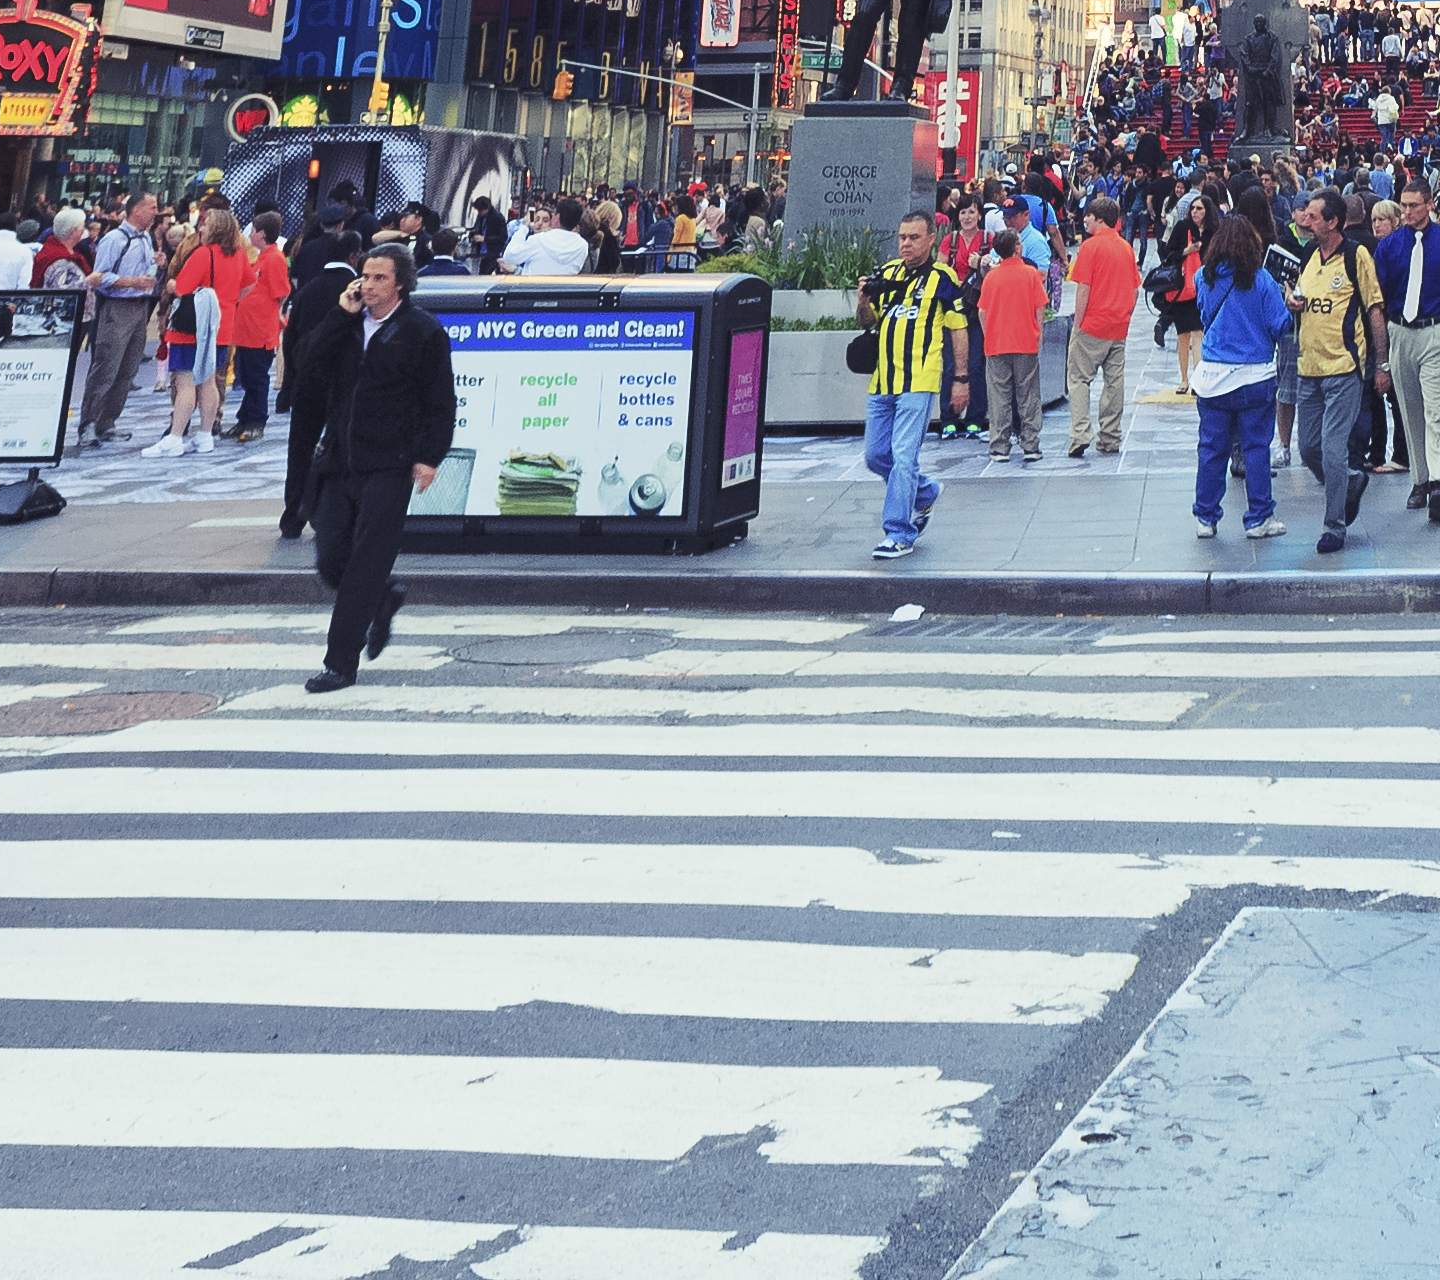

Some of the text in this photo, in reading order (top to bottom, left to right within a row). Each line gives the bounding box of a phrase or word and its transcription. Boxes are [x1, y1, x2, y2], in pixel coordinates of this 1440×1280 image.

[822, 165, 877, 179] GEORGE
[824, 191, 872, 203] COHAN
[477, 319, 685, 339] NYC Green and Clean!
[15, 362, 34, 371] OUT
[4, 373, 28, 381] YORK
[32, 373, 53, 381] CITY
[520, 373, 578, 389] recycle
[619, 372, 677, 388] recycle
[538, 394, 557, 407] all
[619, 393, 675, 406] bottles
[522, 416, 569, 430] paper
[618, 414, 673, 427] & cans
